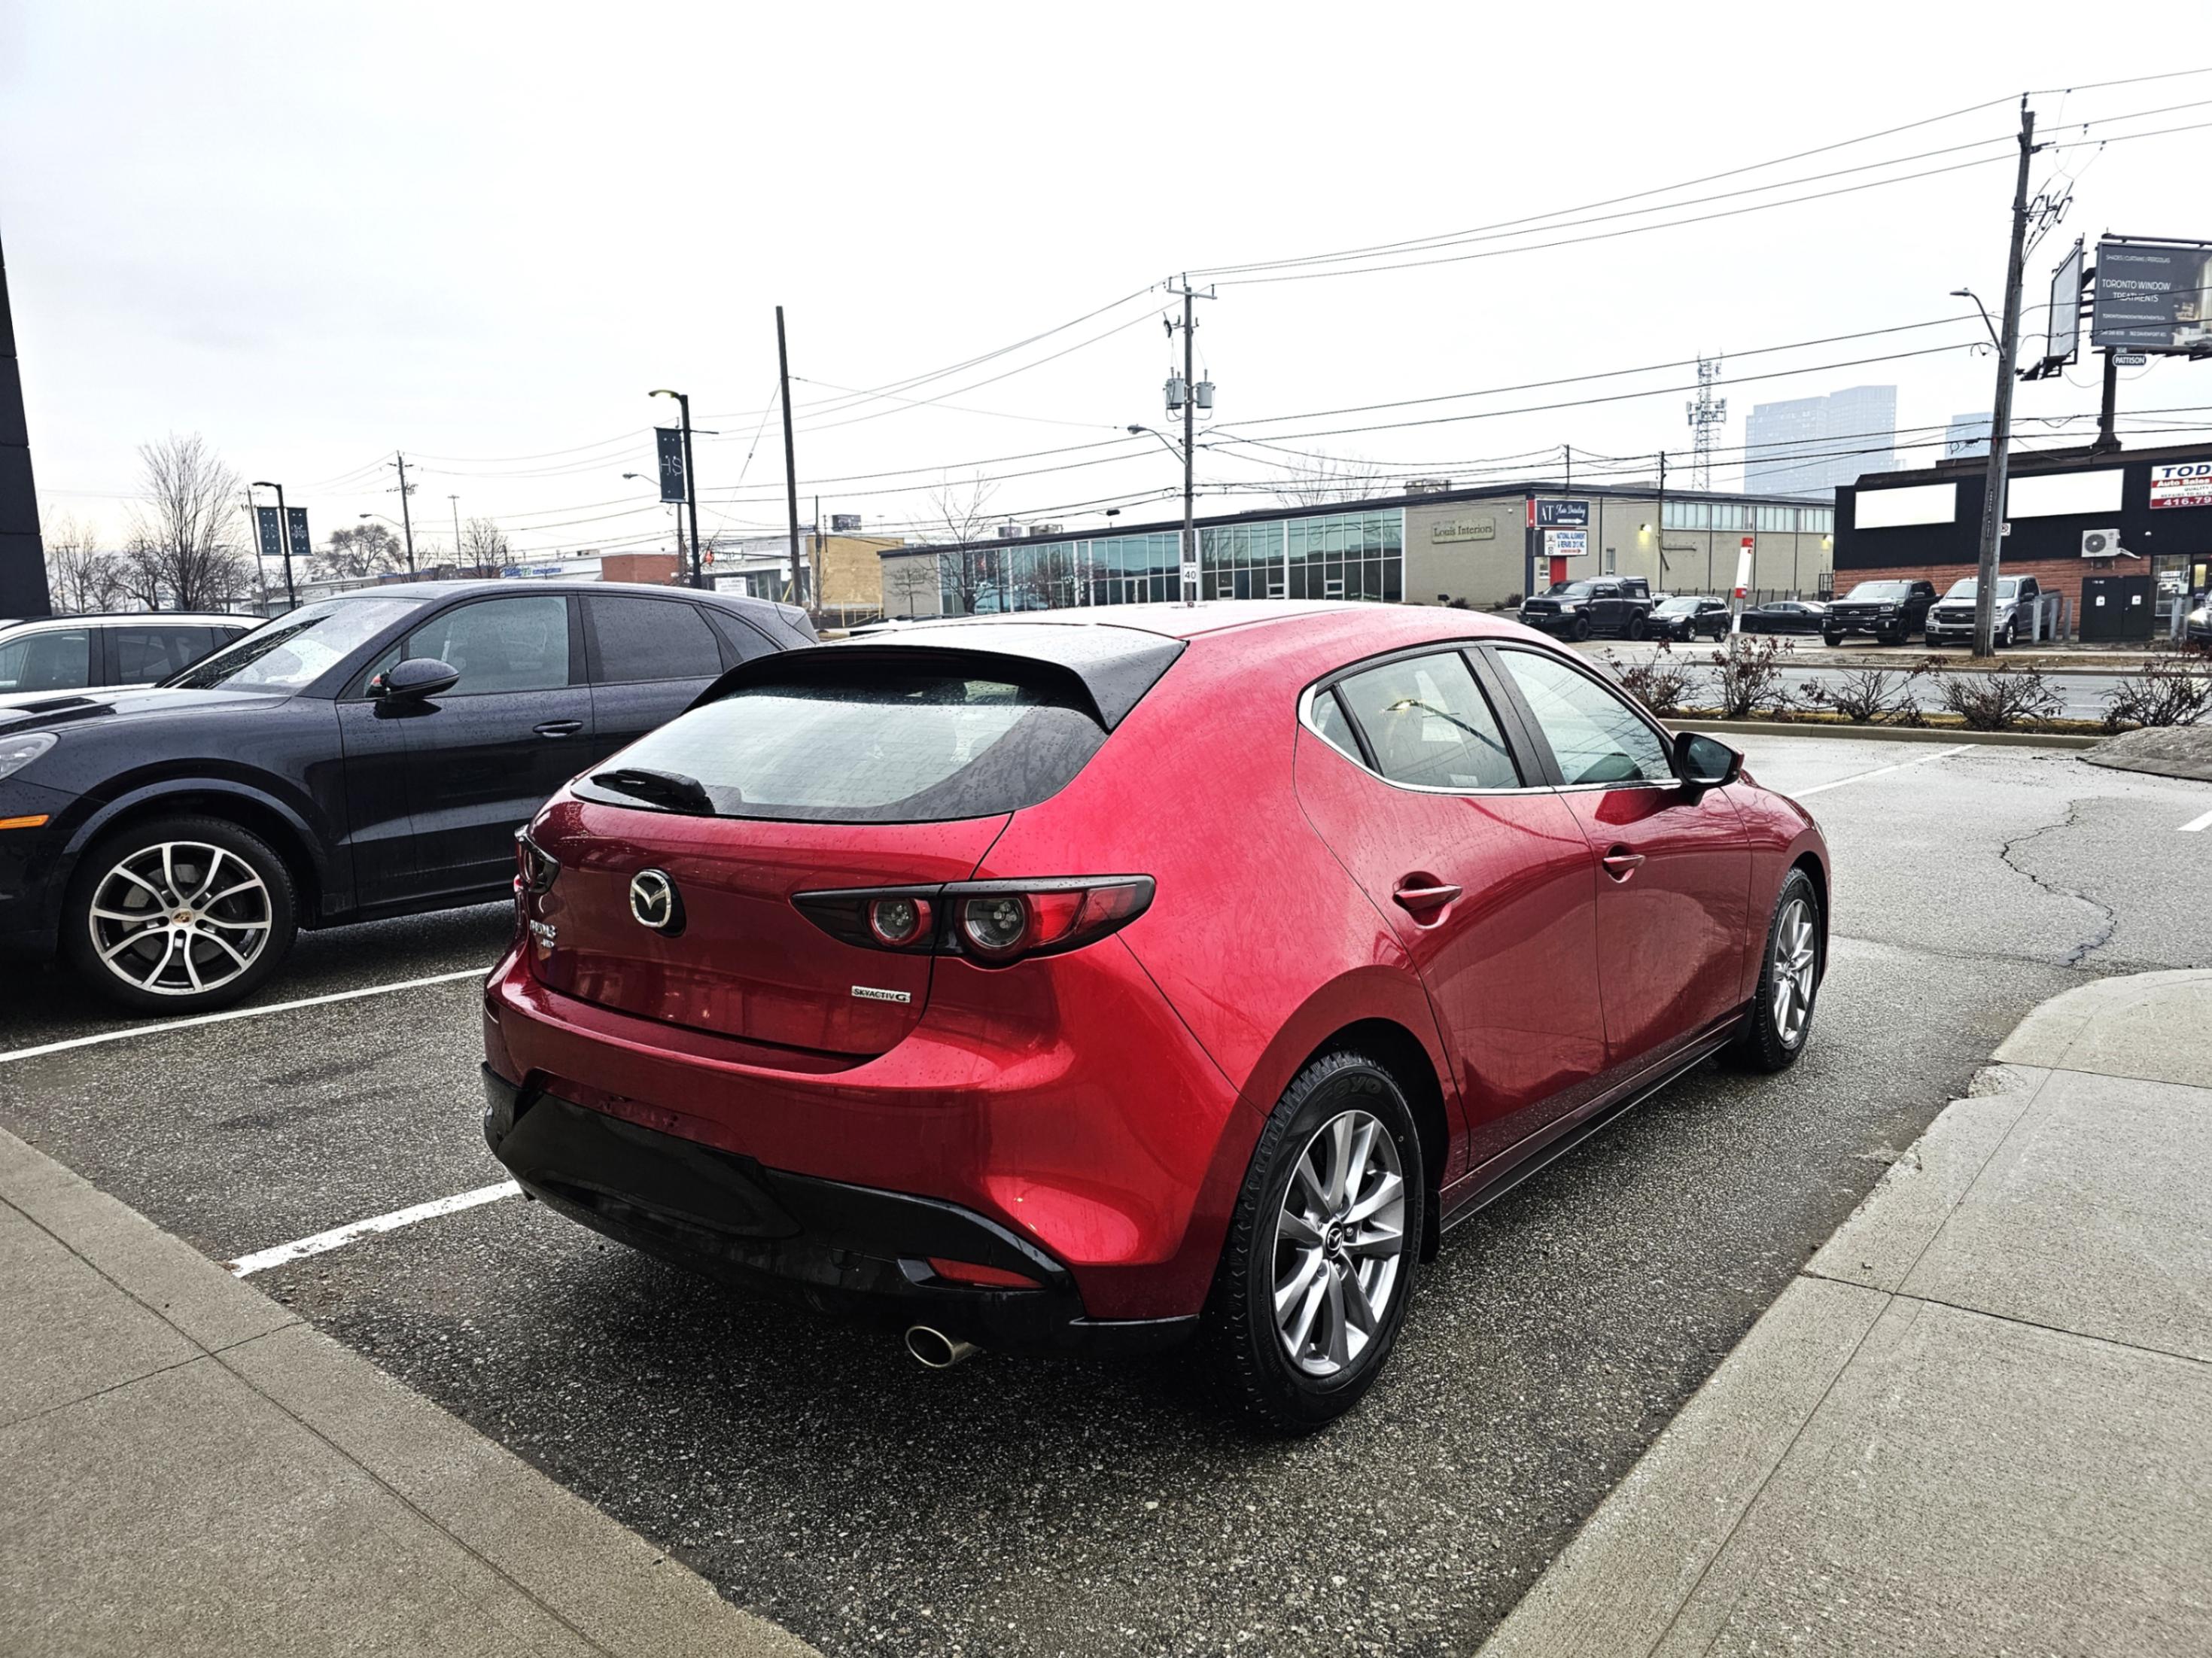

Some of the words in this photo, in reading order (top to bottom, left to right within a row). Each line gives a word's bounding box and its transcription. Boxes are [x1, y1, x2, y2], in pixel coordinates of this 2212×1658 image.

[2102, 279, 2137, 289] TORONTO
[2138, 281, 2171, 291] WINDOW
[2113, 292, 2159, 303] TREATMENTS
[2115, 356, 2145, 364] PATTISON
[2162, 465, 2212, 478] TOD
[1540, 505, 1554, 521] AT
[1434, 527, 1456, 537] Louis
[1458, 524, 1492, 535] Interiors
[1185, 570, 1197, 580] 40
[853, 988, 895, 999] SKYACTIV
